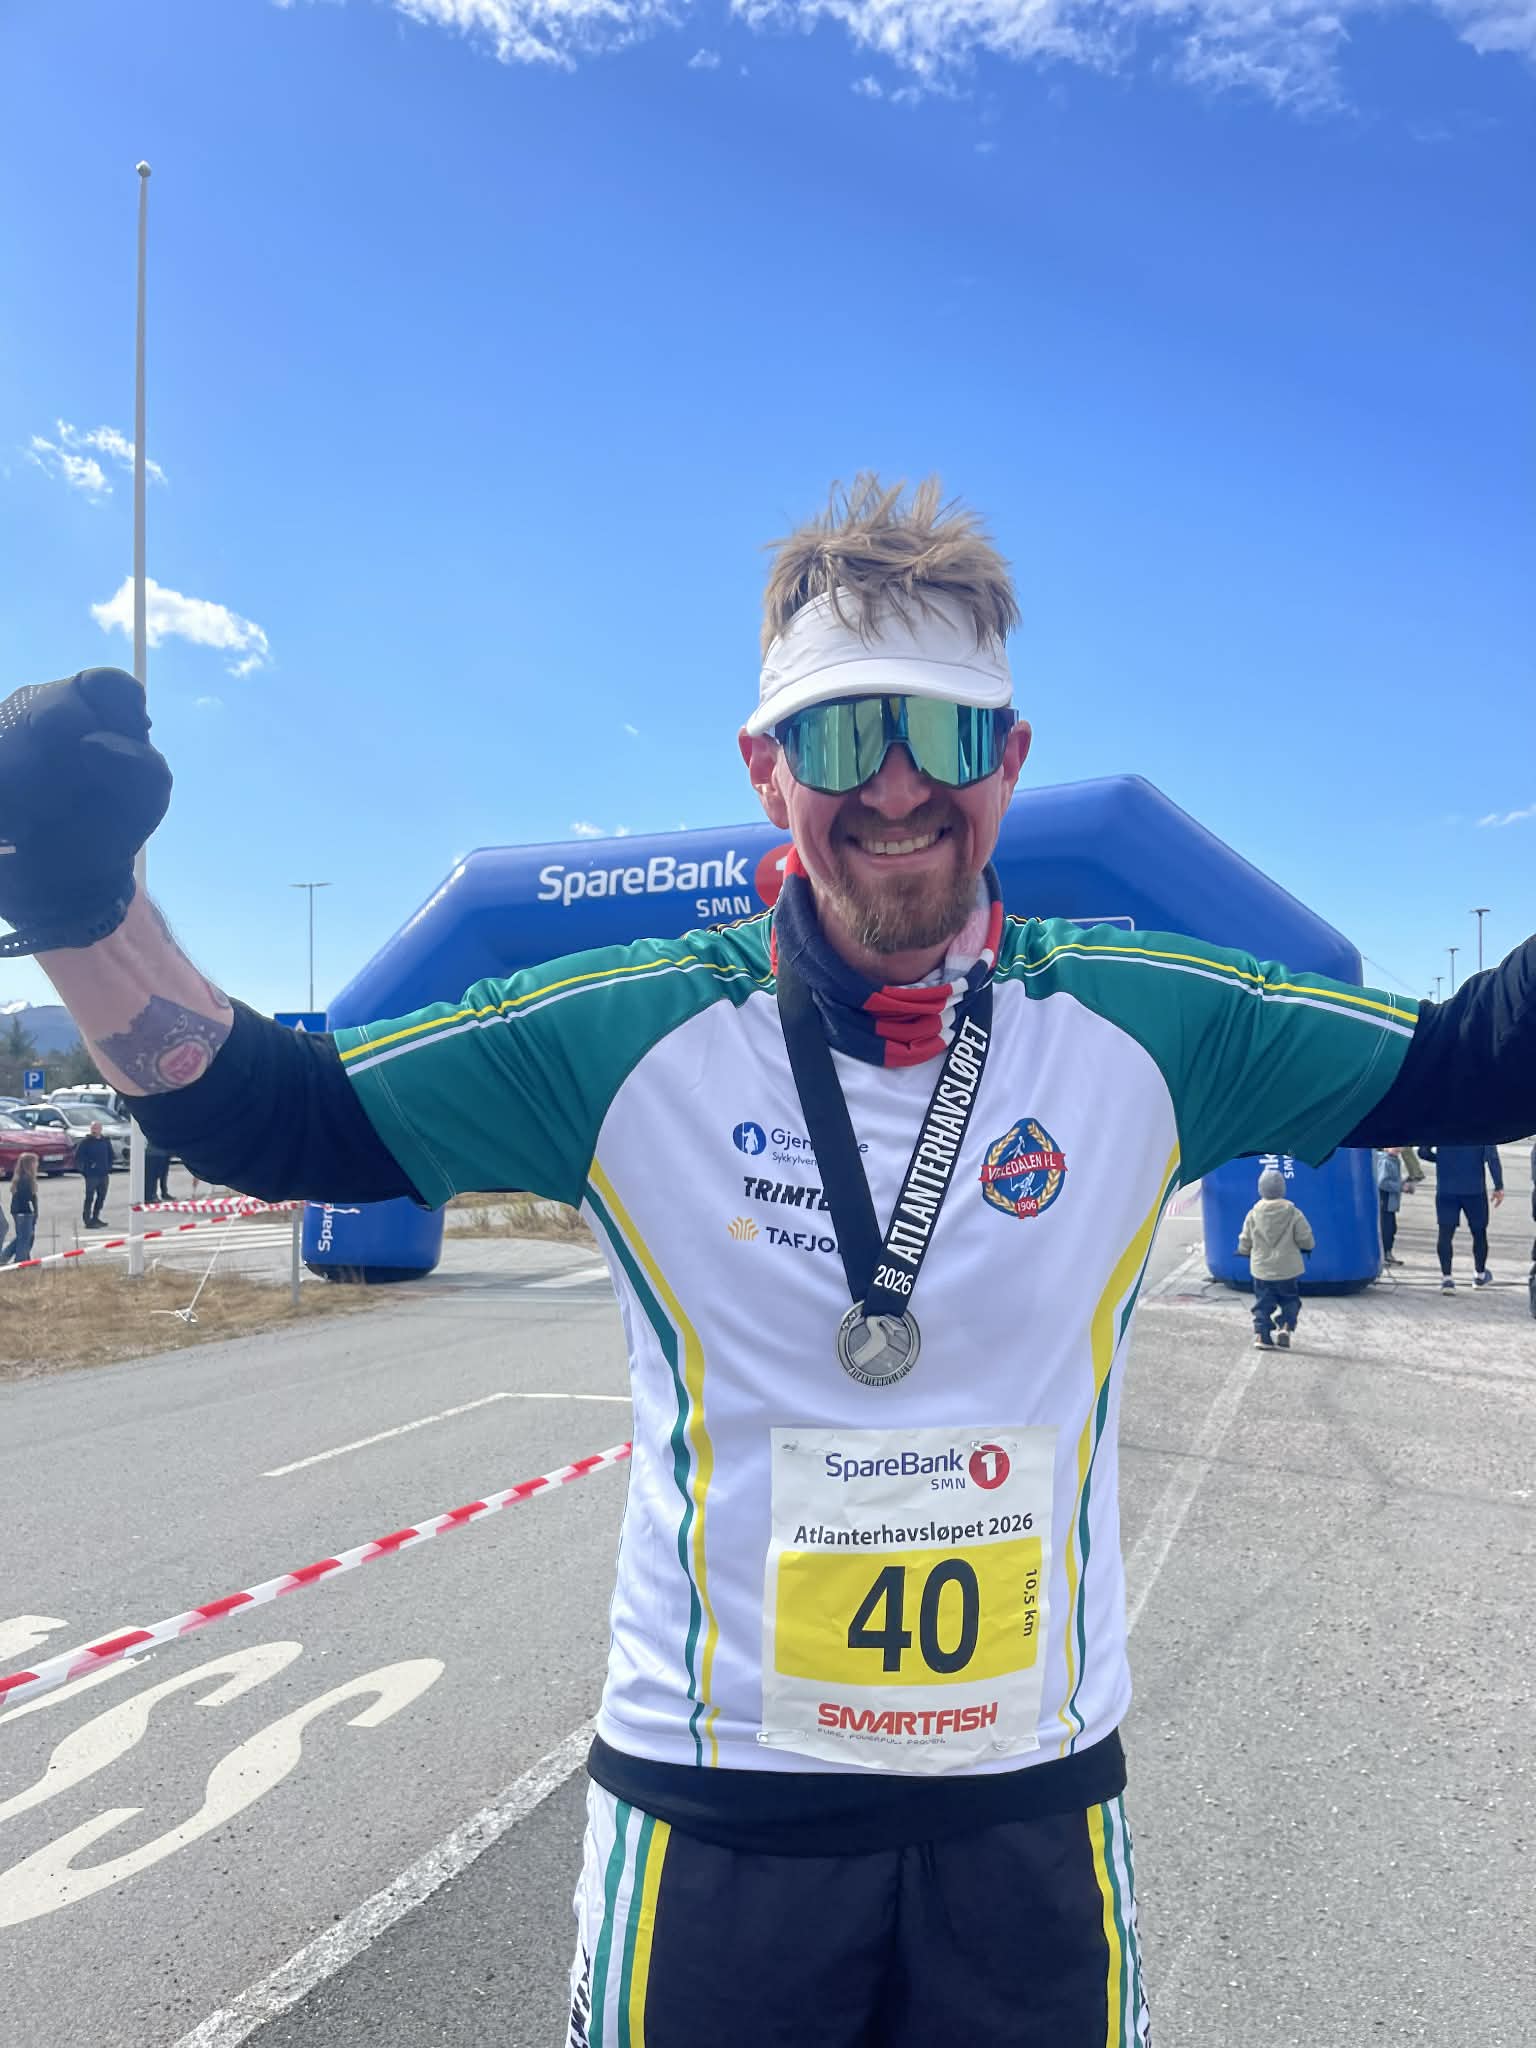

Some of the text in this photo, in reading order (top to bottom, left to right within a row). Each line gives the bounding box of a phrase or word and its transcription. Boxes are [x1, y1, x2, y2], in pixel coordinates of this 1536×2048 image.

[537, 850, 749, 906] SpareBank
[695, 895, 751, 918] SMN
[29, 1072, 40, 1088] P
[887, 1015, 988, 1265] ATLANTERHAVSLØPET
[1017, 1199, 1037, 1212] 1906
[765, 1226, 840, 1254] TAFJO
[873, 1265, 913, 1295] 2026
[825, 1448, 997, 1482] SpareBank 1
[931, 1477, 966, 1490] SMN
[793, 1512, 1034, 1545] Atlanterhavsløpet 2026
[847, 1558, 980, 1674] 40
[1023, 1568, 1038, 1637] 10,5 km
[817, 1702, 999, 1736] SMARTFISH
